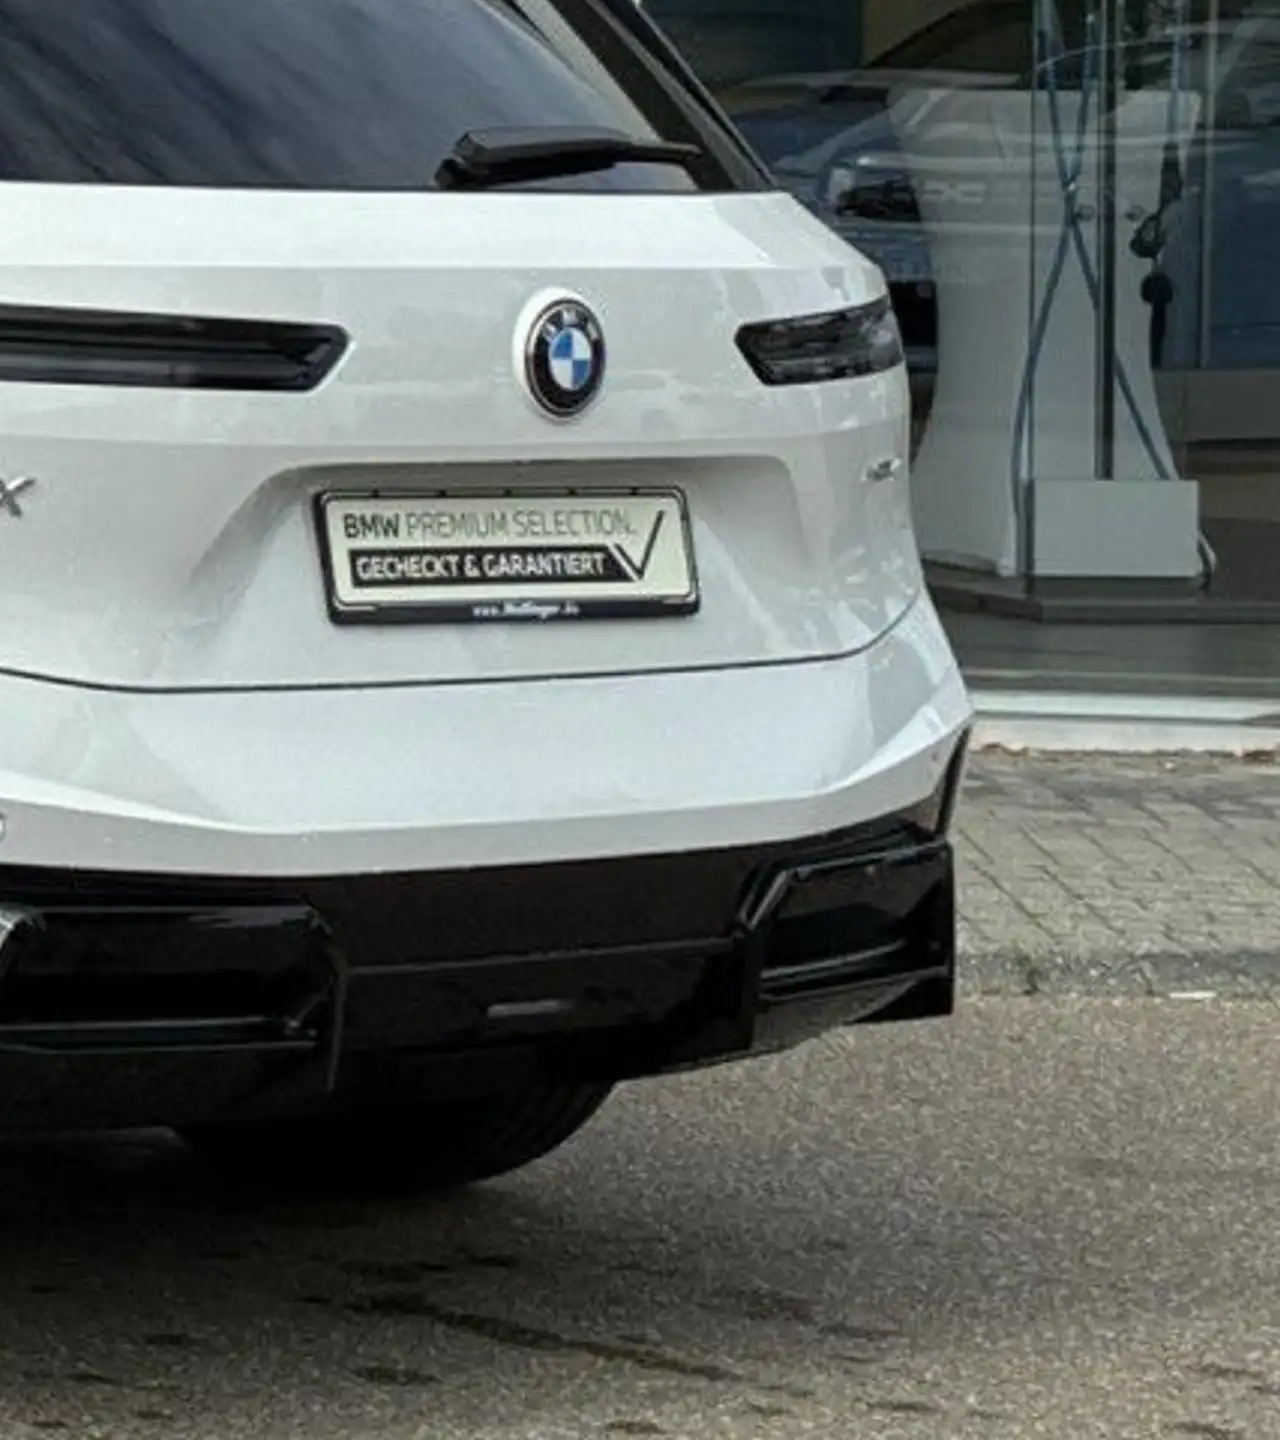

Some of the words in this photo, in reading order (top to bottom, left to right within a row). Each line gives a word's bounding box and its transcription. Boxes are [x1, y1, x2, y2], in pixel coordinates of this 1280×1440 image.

[344, 514, 399, 540] BMW
[406, 513, 509, 539] PREMIUM
[356, 554, 460, 581] GECHECKT
[464, 555, 480, 578] &
[482, 550, 606, 578] GARANTIERT
